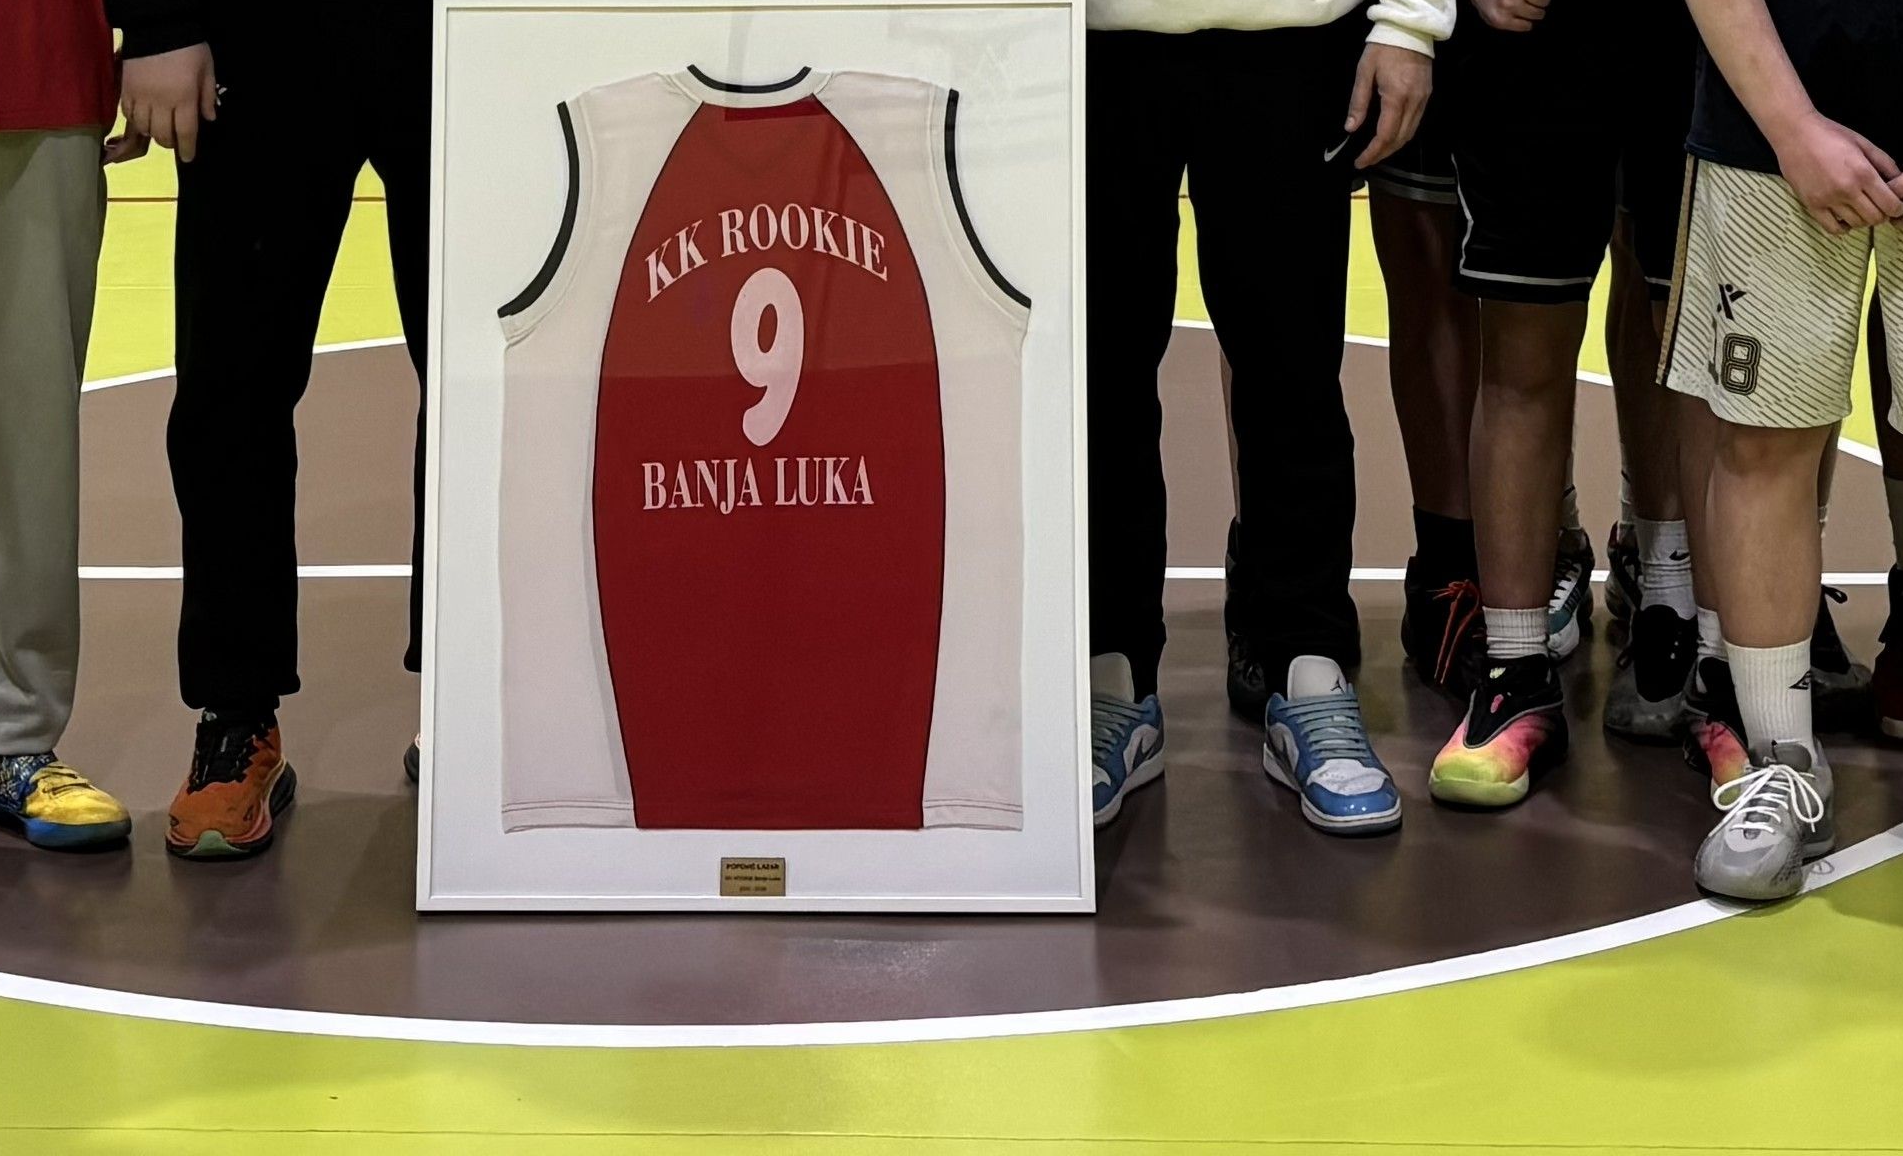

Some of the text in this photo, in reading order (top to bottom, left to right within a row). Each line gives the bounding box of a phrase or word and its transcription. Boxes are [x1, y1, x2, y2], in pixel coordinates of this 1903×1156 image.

[645, 203, 888, 303] KK ROOKIE
[730, 267, 805, 447] 9
[1720, 333, 1761, 396] 8
[642, 455, 875, 515] BANJA LUKA
